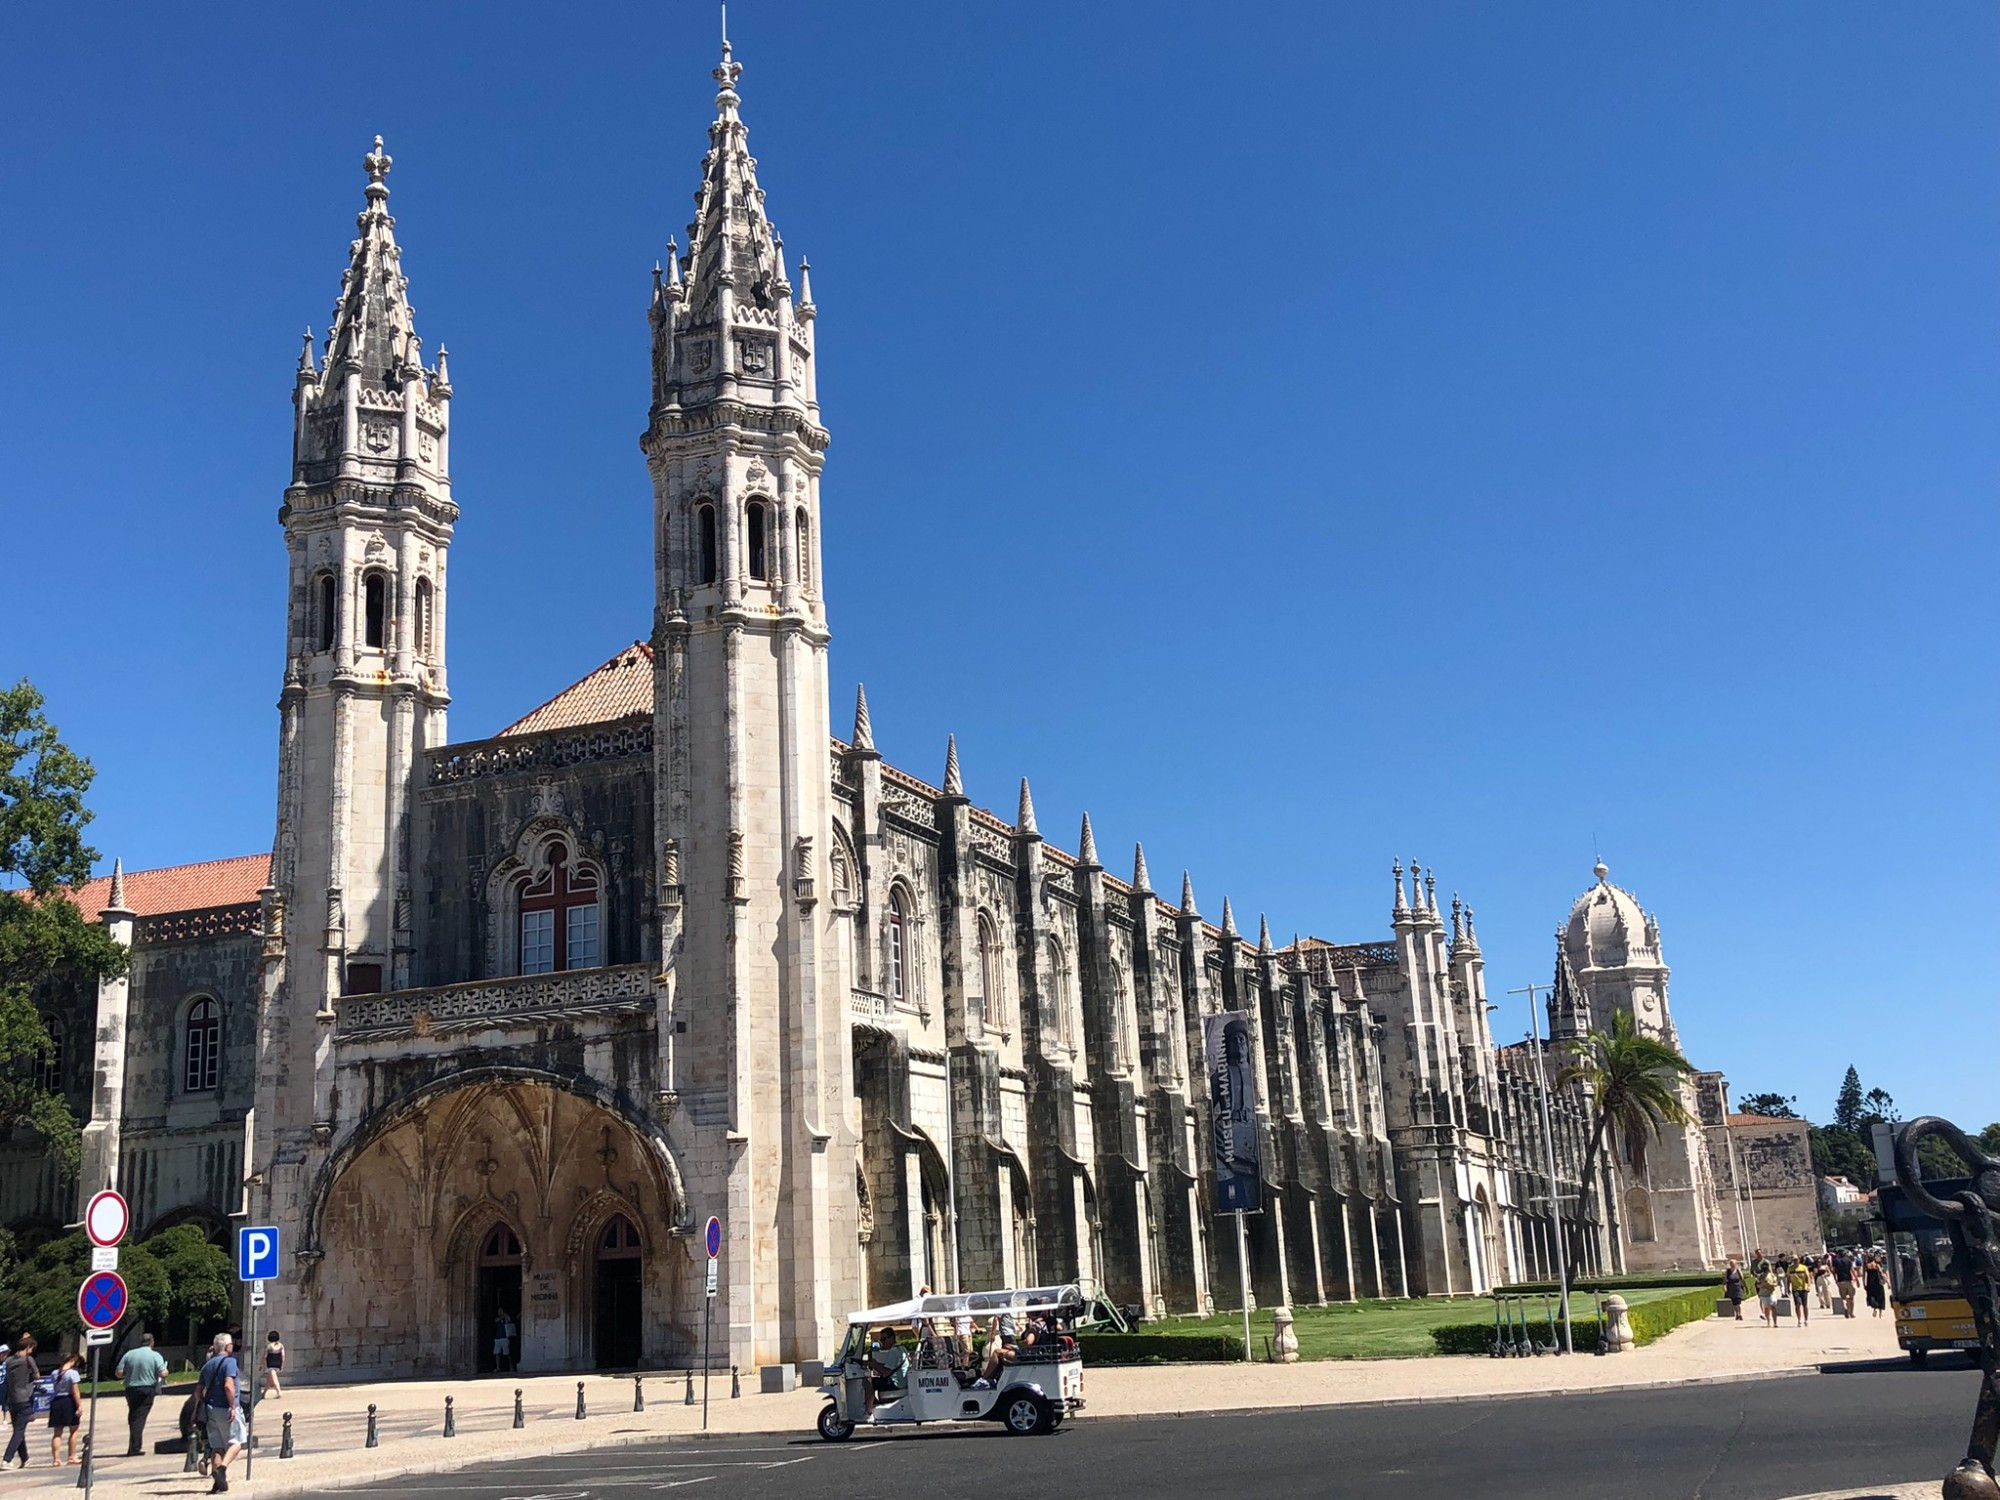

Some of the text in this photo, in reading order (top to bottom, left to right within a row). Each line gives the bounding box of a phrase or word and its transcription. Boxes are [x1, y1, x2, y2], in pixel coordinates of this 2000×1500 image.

[1213, 1027, 1230, 1096] MARINHA
[1222, 1110, 1235, 1163] MUSEU
[248, 1232, 271, 1275] P
[918, 1376, 949, 1388] MON AMI
